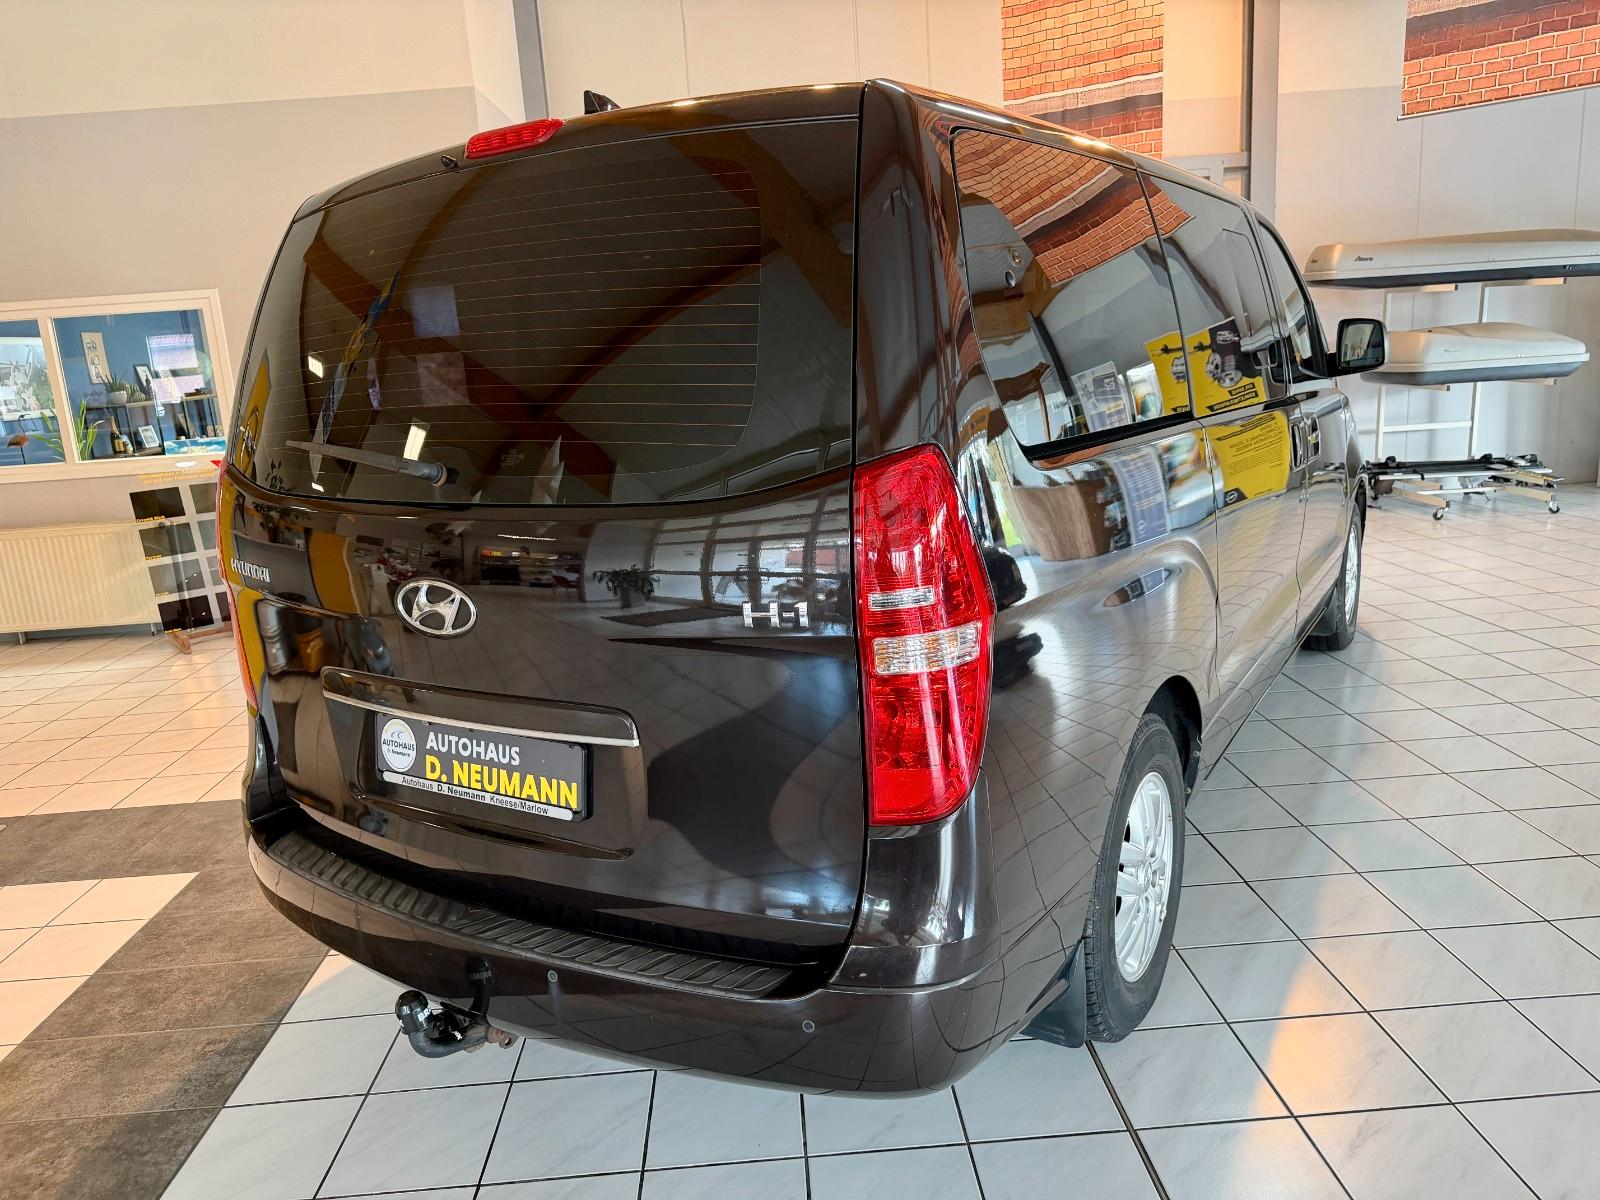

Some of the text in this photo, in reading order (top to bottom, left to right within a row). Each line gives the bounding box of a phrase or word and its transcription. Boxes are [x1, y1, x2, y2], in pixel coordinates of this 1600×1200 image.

[230, 557, 271, 583] HYUNDAI
[742, 601, 809, 628] H-1
[382, 738, 416, 752] AUTOHAUS
[425, 731, 520, 766] AUTOHAUS
[401, 776, 549, 815] Autohaus D. Neumann Kneese/Marlow
[425, 754, 578, 811] D. NEUMANN
